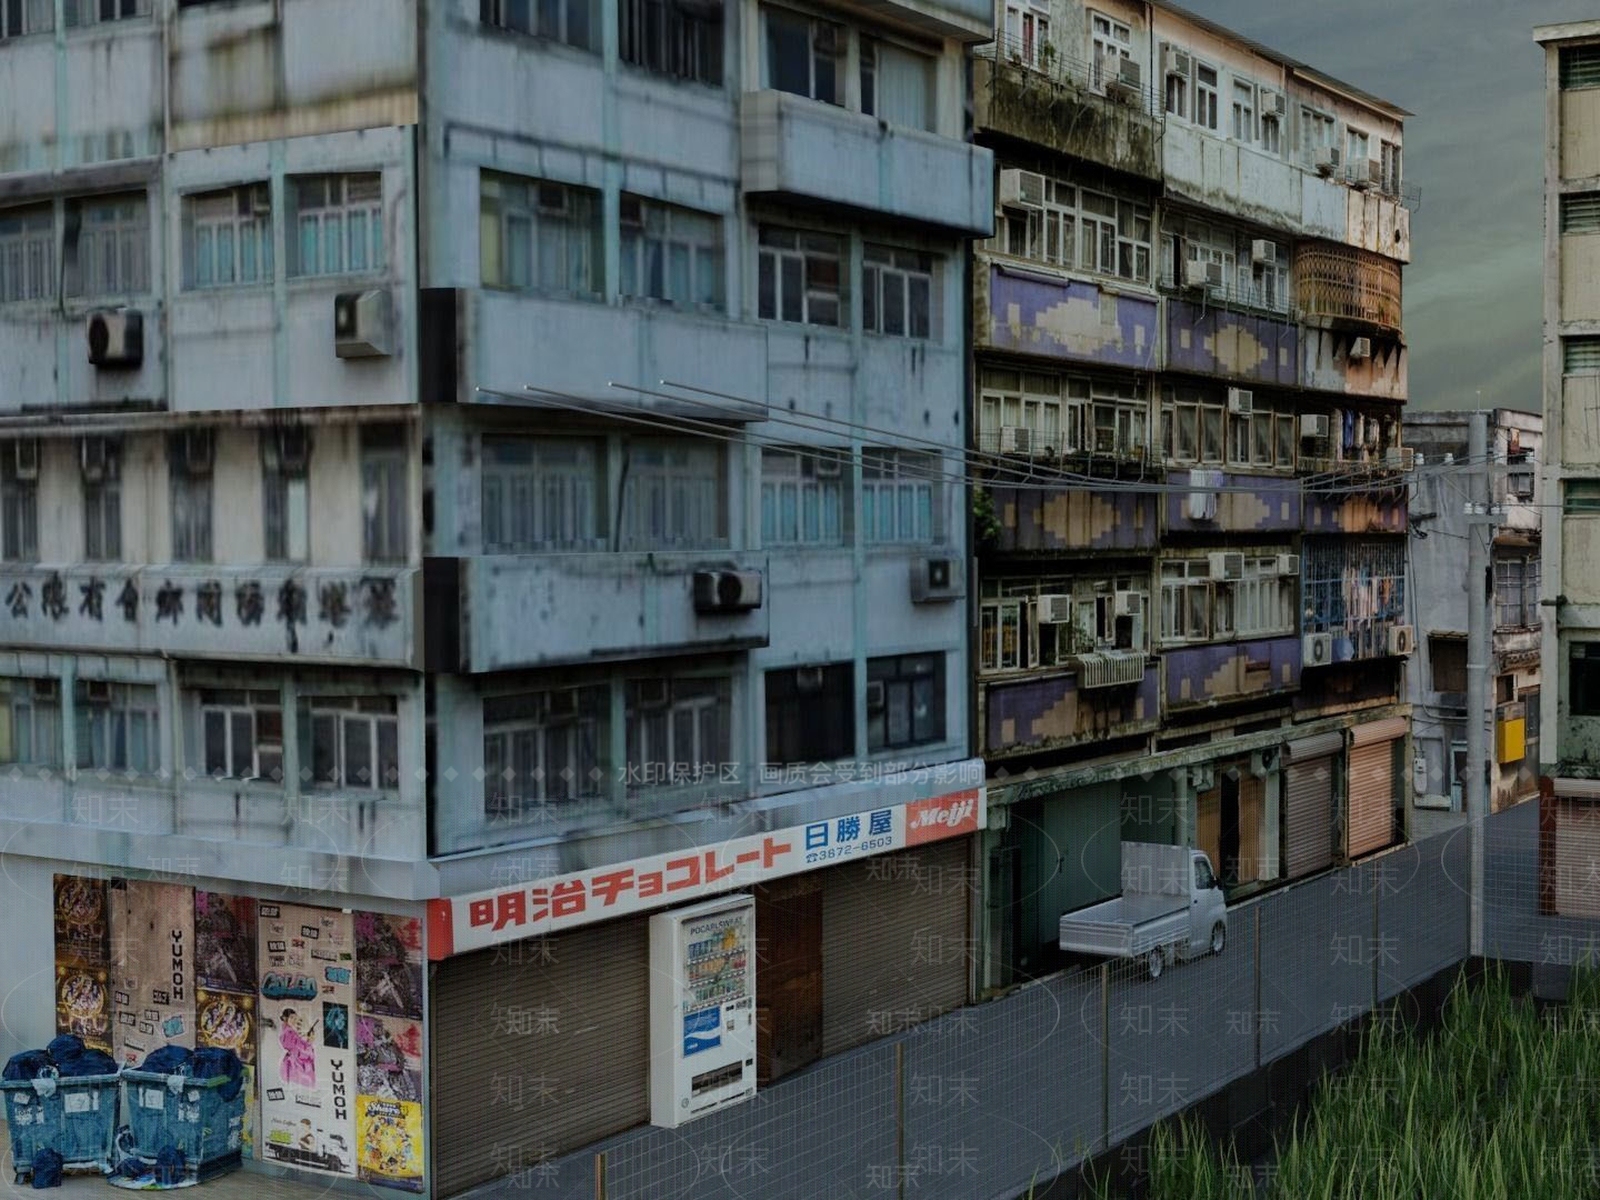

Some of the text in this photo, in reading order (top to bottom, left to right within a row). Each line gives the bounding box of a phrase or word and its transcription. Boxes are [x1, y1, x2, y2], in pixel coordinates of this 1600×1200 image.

[805, 809, 893, 851] 日勝屋
[910, 798, 975, 829] Meiji
[469, 837, 792, 931] 明治チョコレート
[171, 930, 184, 1001] YUMOH
[330, 1059, 348, 1121] YUMOH
